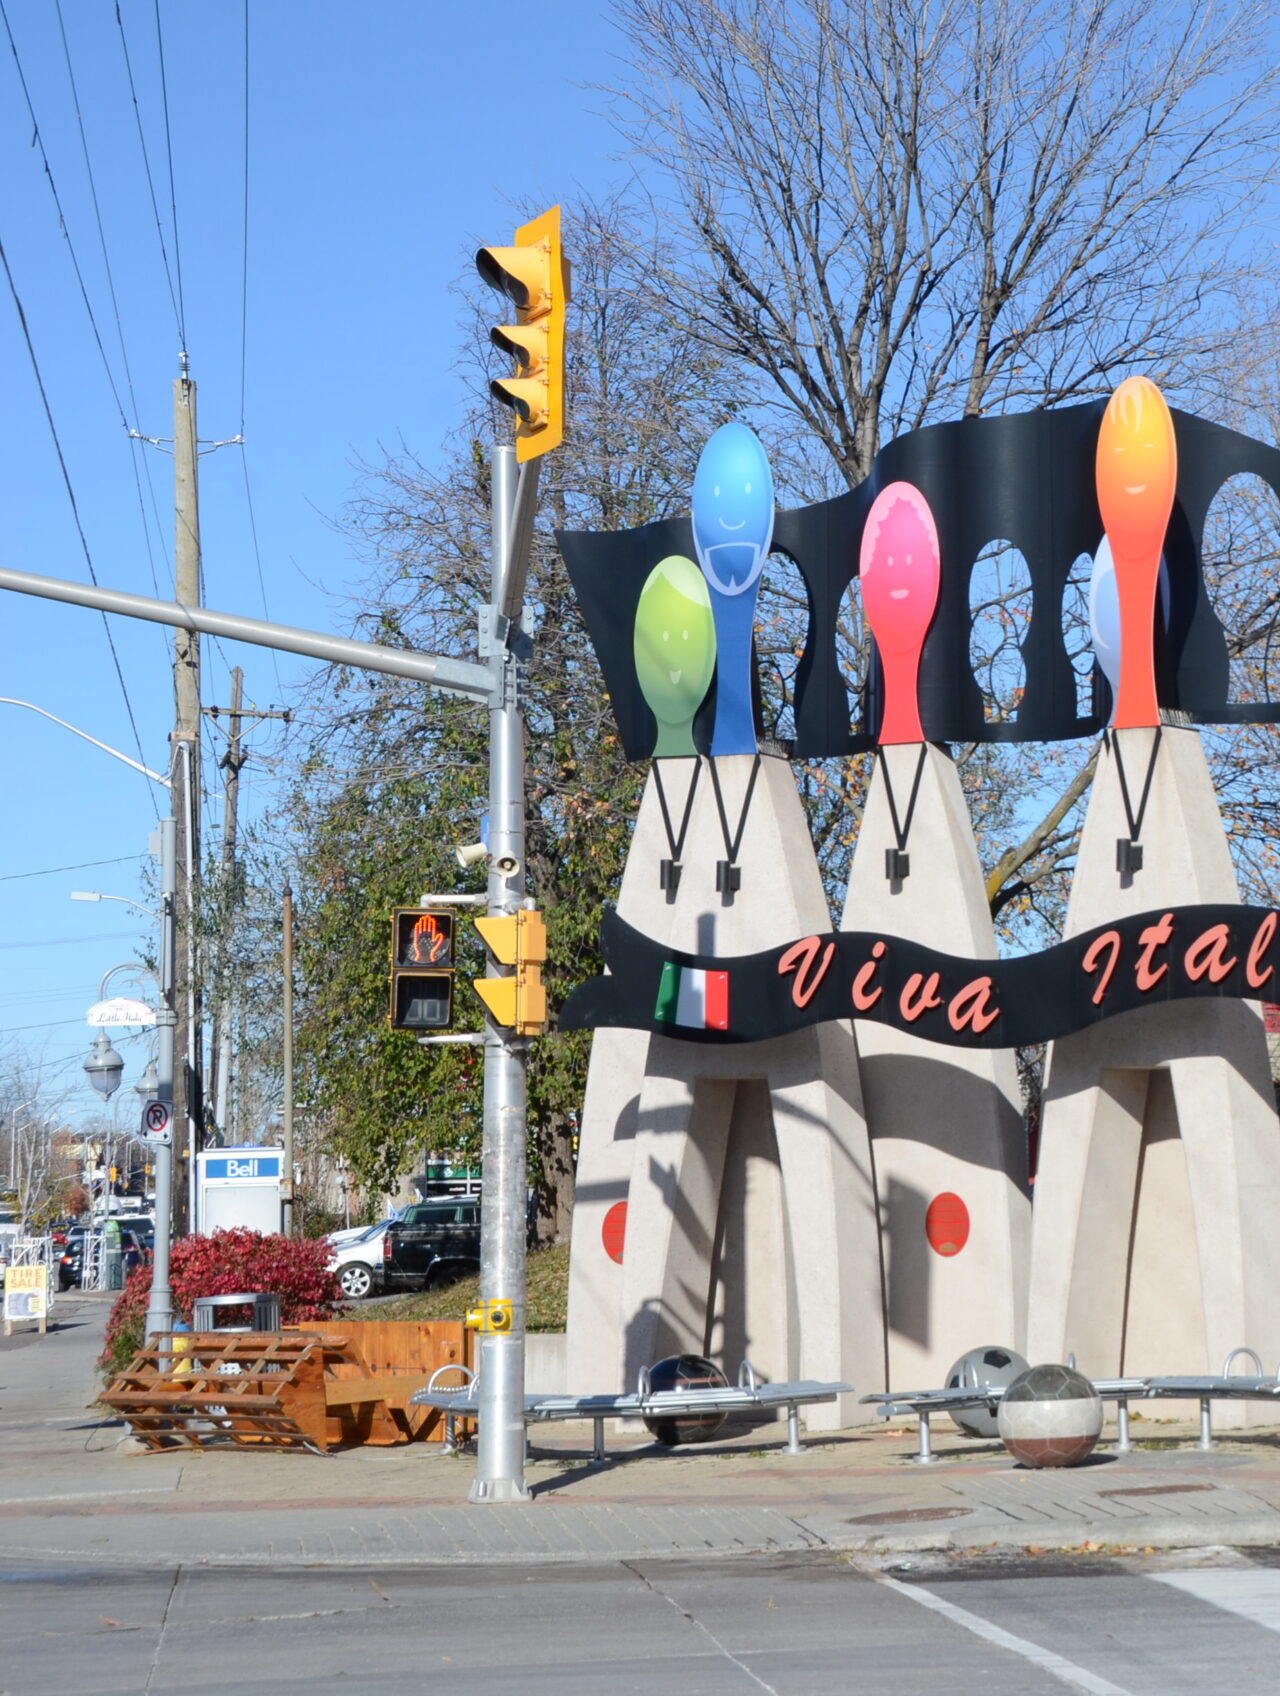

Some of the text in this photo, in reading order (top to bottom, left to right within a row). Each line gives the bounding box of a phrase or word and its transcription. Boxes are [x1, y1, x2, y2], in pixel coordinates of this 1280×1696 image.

[778, 935, 1000, 1033] Viva
[226, 1159, 259, 1177] Bell
[10, 1268, 42, 1278] TIRE
[10, 1279, 42, 1288] SALE
